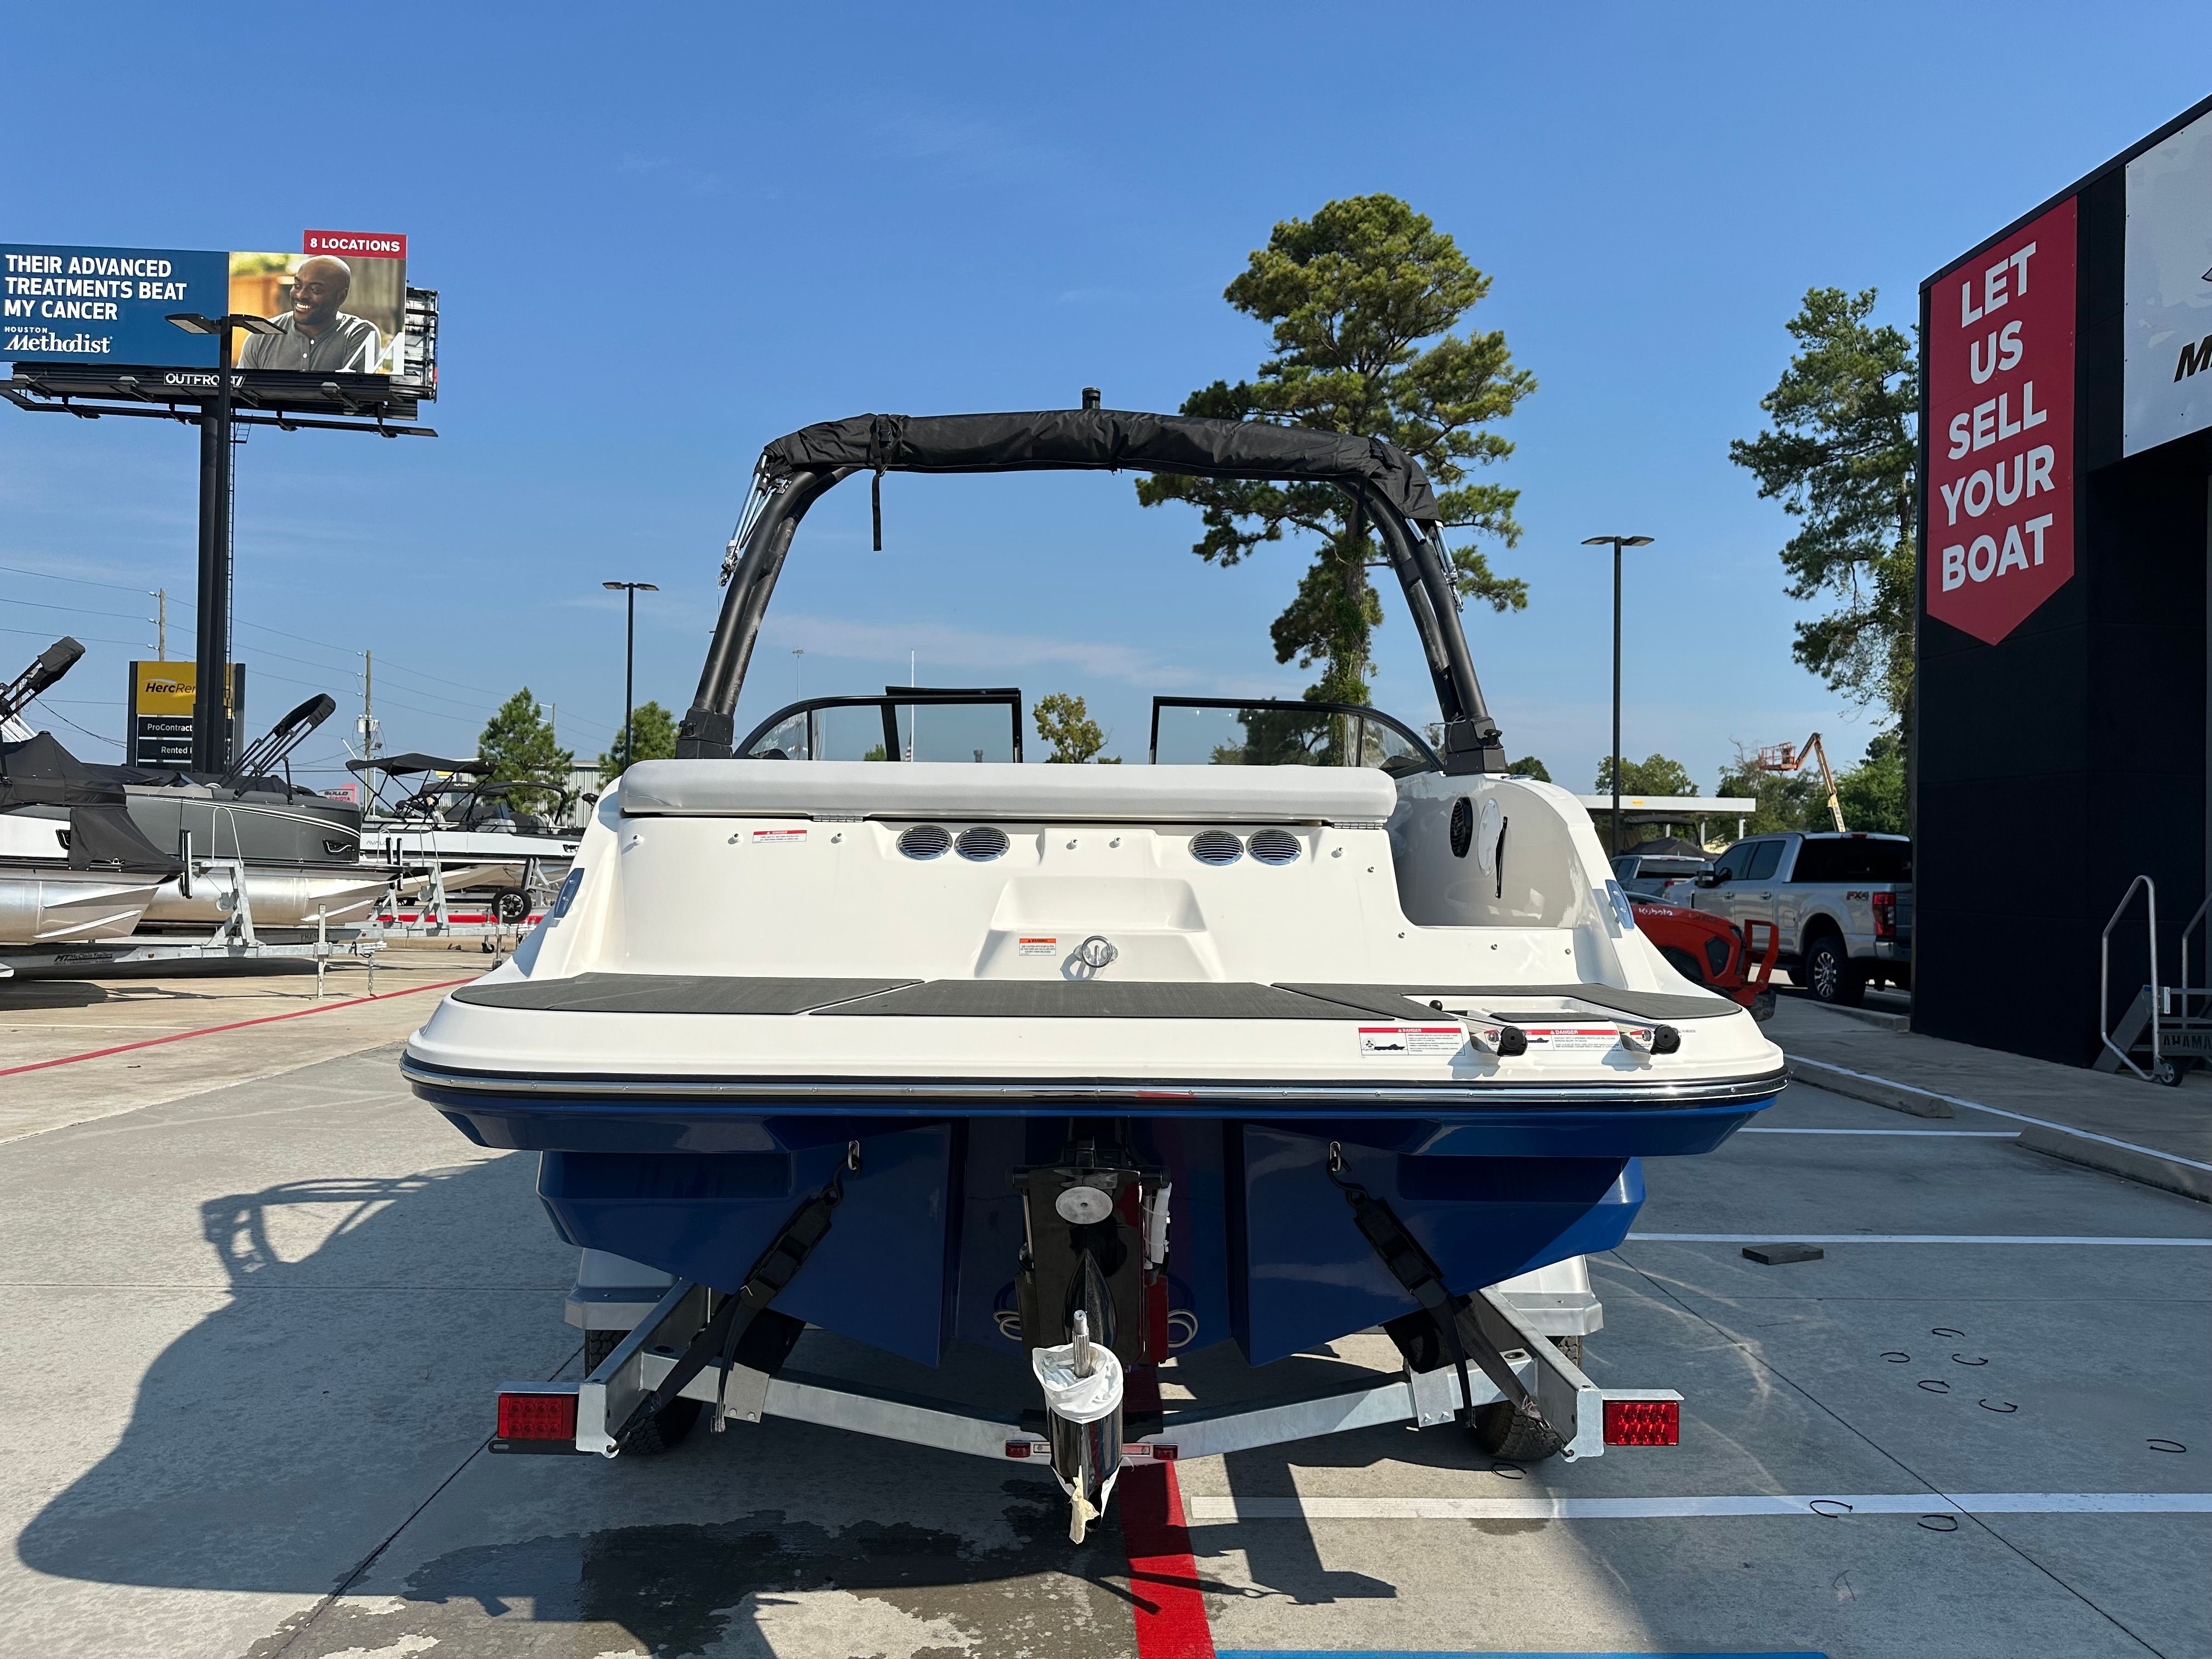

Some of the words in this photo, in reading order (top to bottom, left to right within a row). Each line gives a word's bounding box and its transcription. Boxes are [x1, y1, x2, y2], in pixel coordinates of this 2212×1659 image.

[310, 238, 317, 247] 8
[321, 238, 400, 252] LOCATIONS
[5, 254, 62, 273] THEIR
[69, 257, 171, 277] ADVANCED
[5, 276, 133, 298] TREATMENTS
[139, 282, 187, 300] BEAT
[1962, 241, 2036, 328] LET
[4, 299, 35, 317] MY
[42, 301, 117, 320] CANCER
[4, 332, 110, 353] Methodist
[1970, 320, 2023, 385] US
[2174, 334, 2212, 383] M
[1948, 381, 2047, 460] SELL
[1940, 445, 2055, 526] YOUR
[1942, 513, 2053, 591] BOAT
[1846, 891, 1869, 900] FX4
[1639, 907, 1673, 916] Kubota
